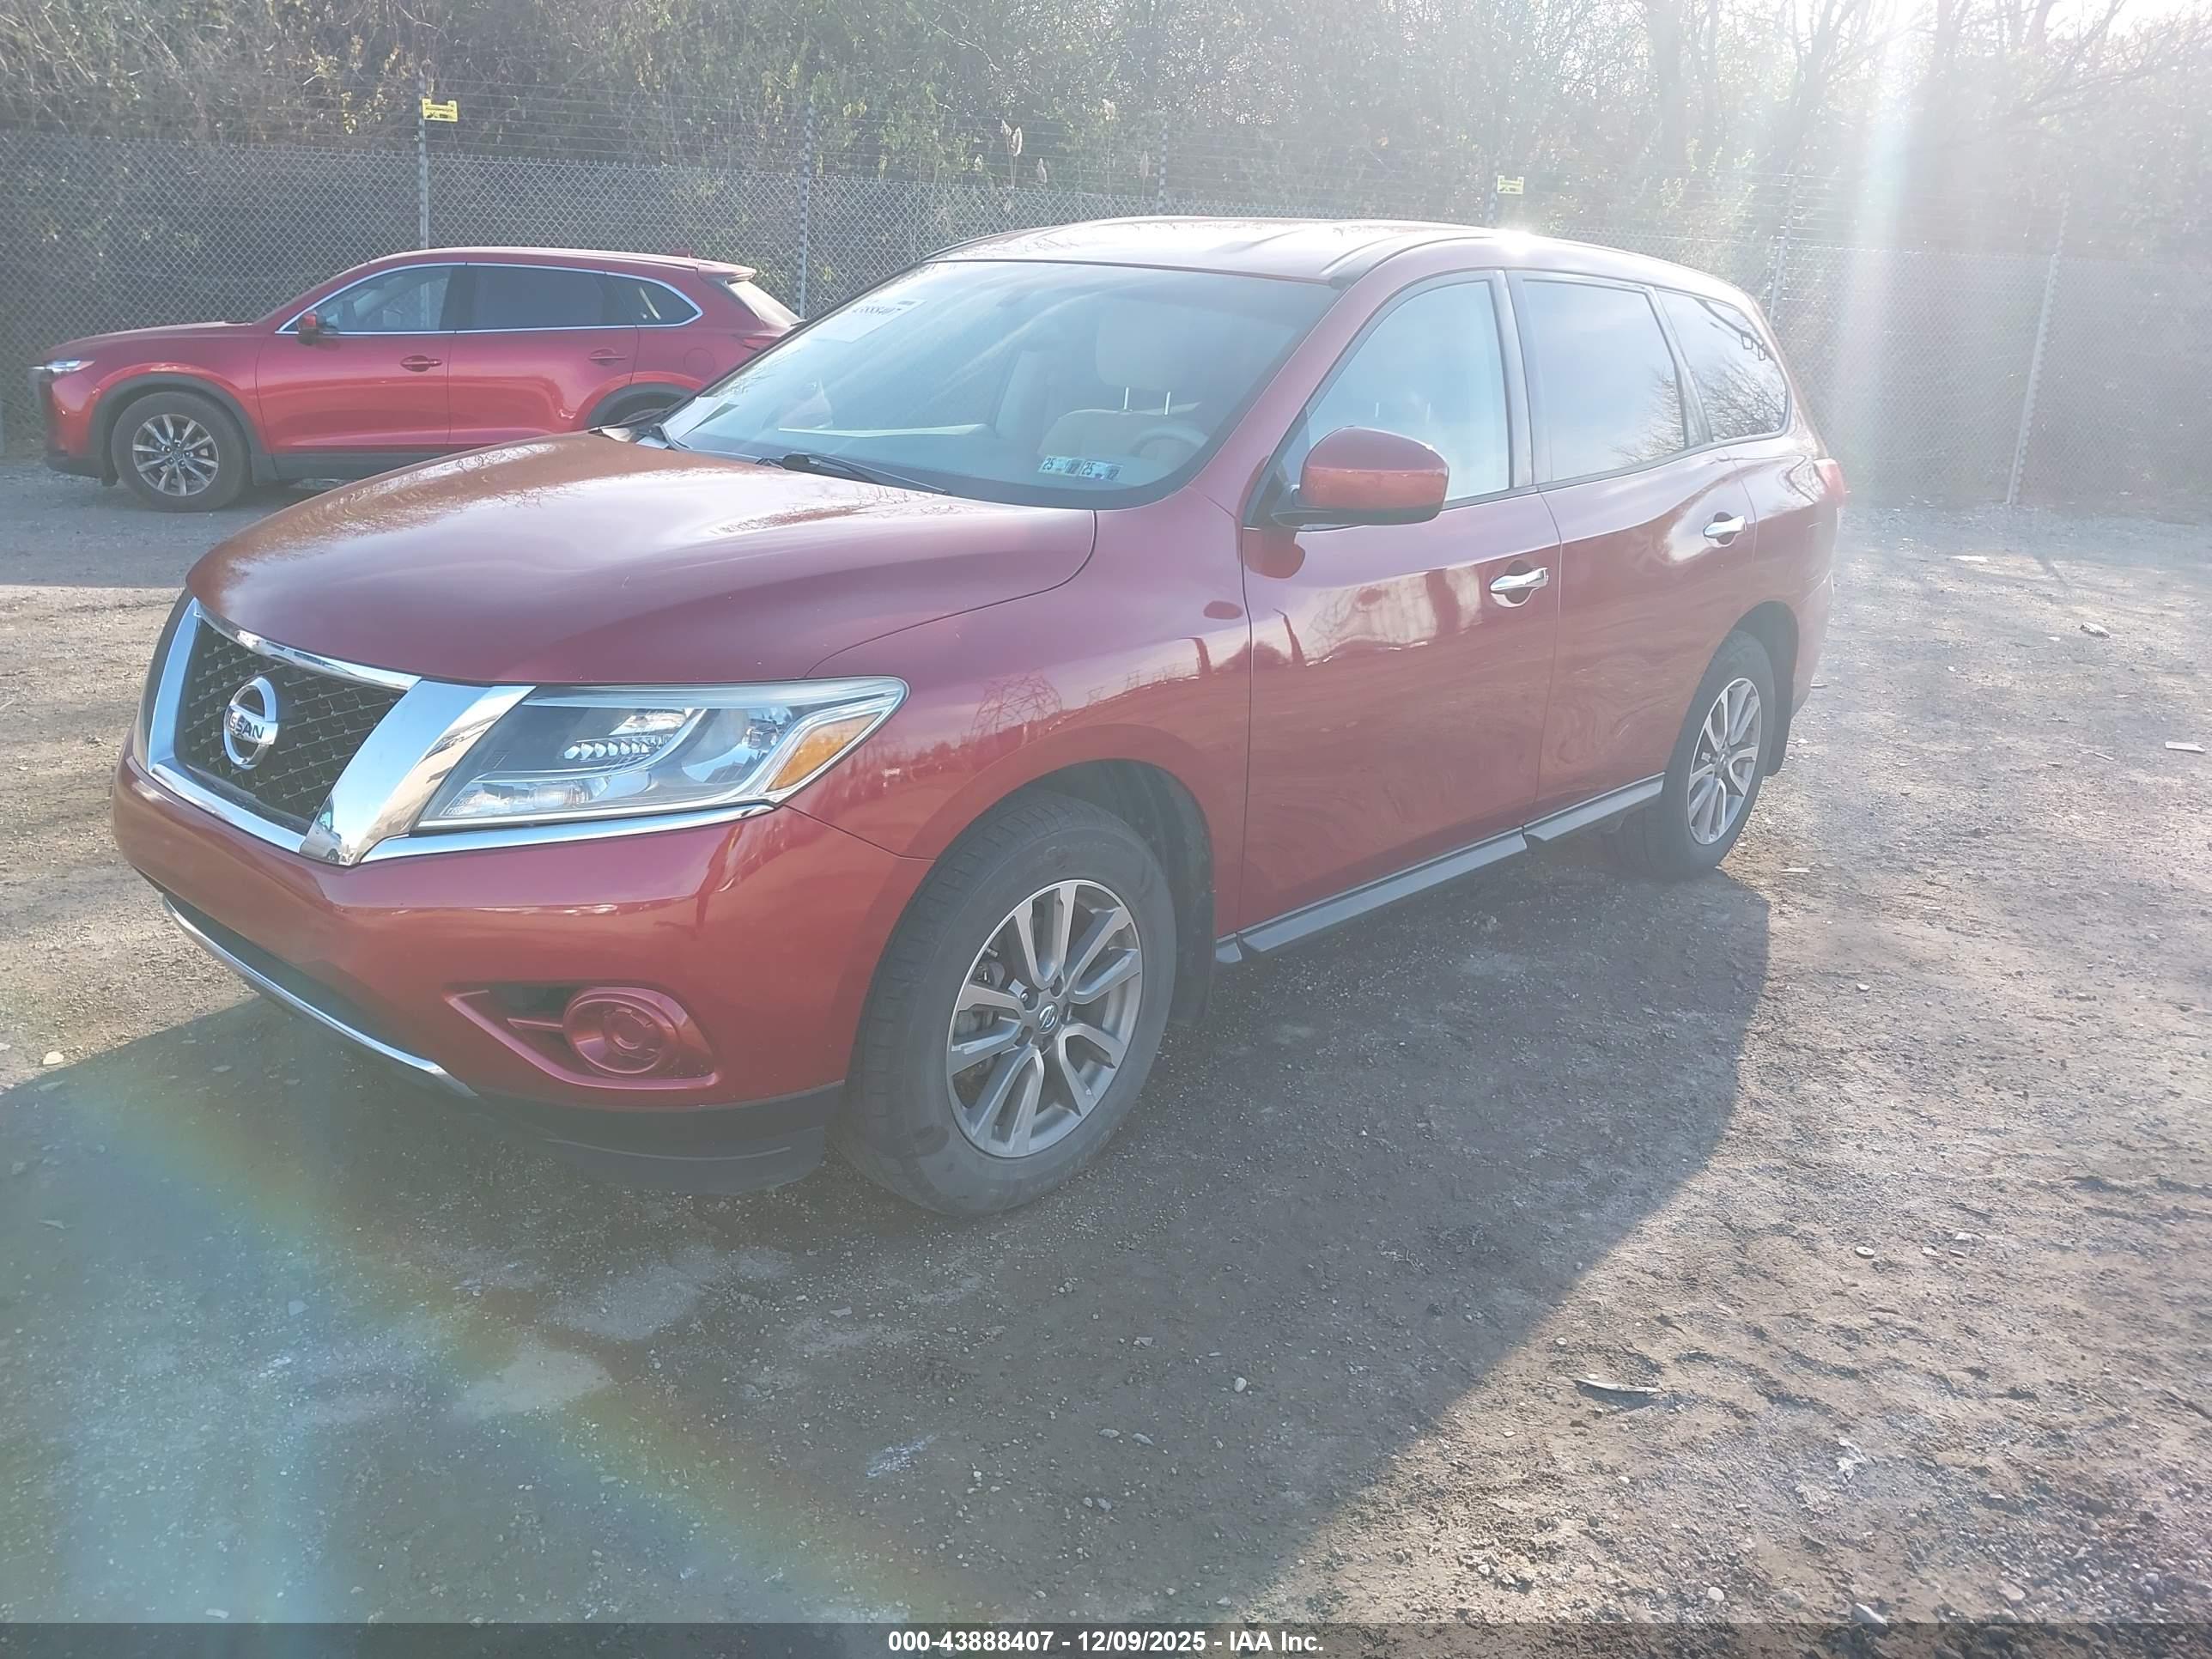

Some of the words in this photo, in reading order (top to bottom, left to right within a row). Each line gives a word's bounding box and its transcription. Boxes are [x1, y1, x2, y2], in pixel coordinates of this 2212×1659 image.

[1042, 457, 1056, 471] 25
[1081, 461, 1097, 476] 25
[227, 714, 265, 739] SSAN
